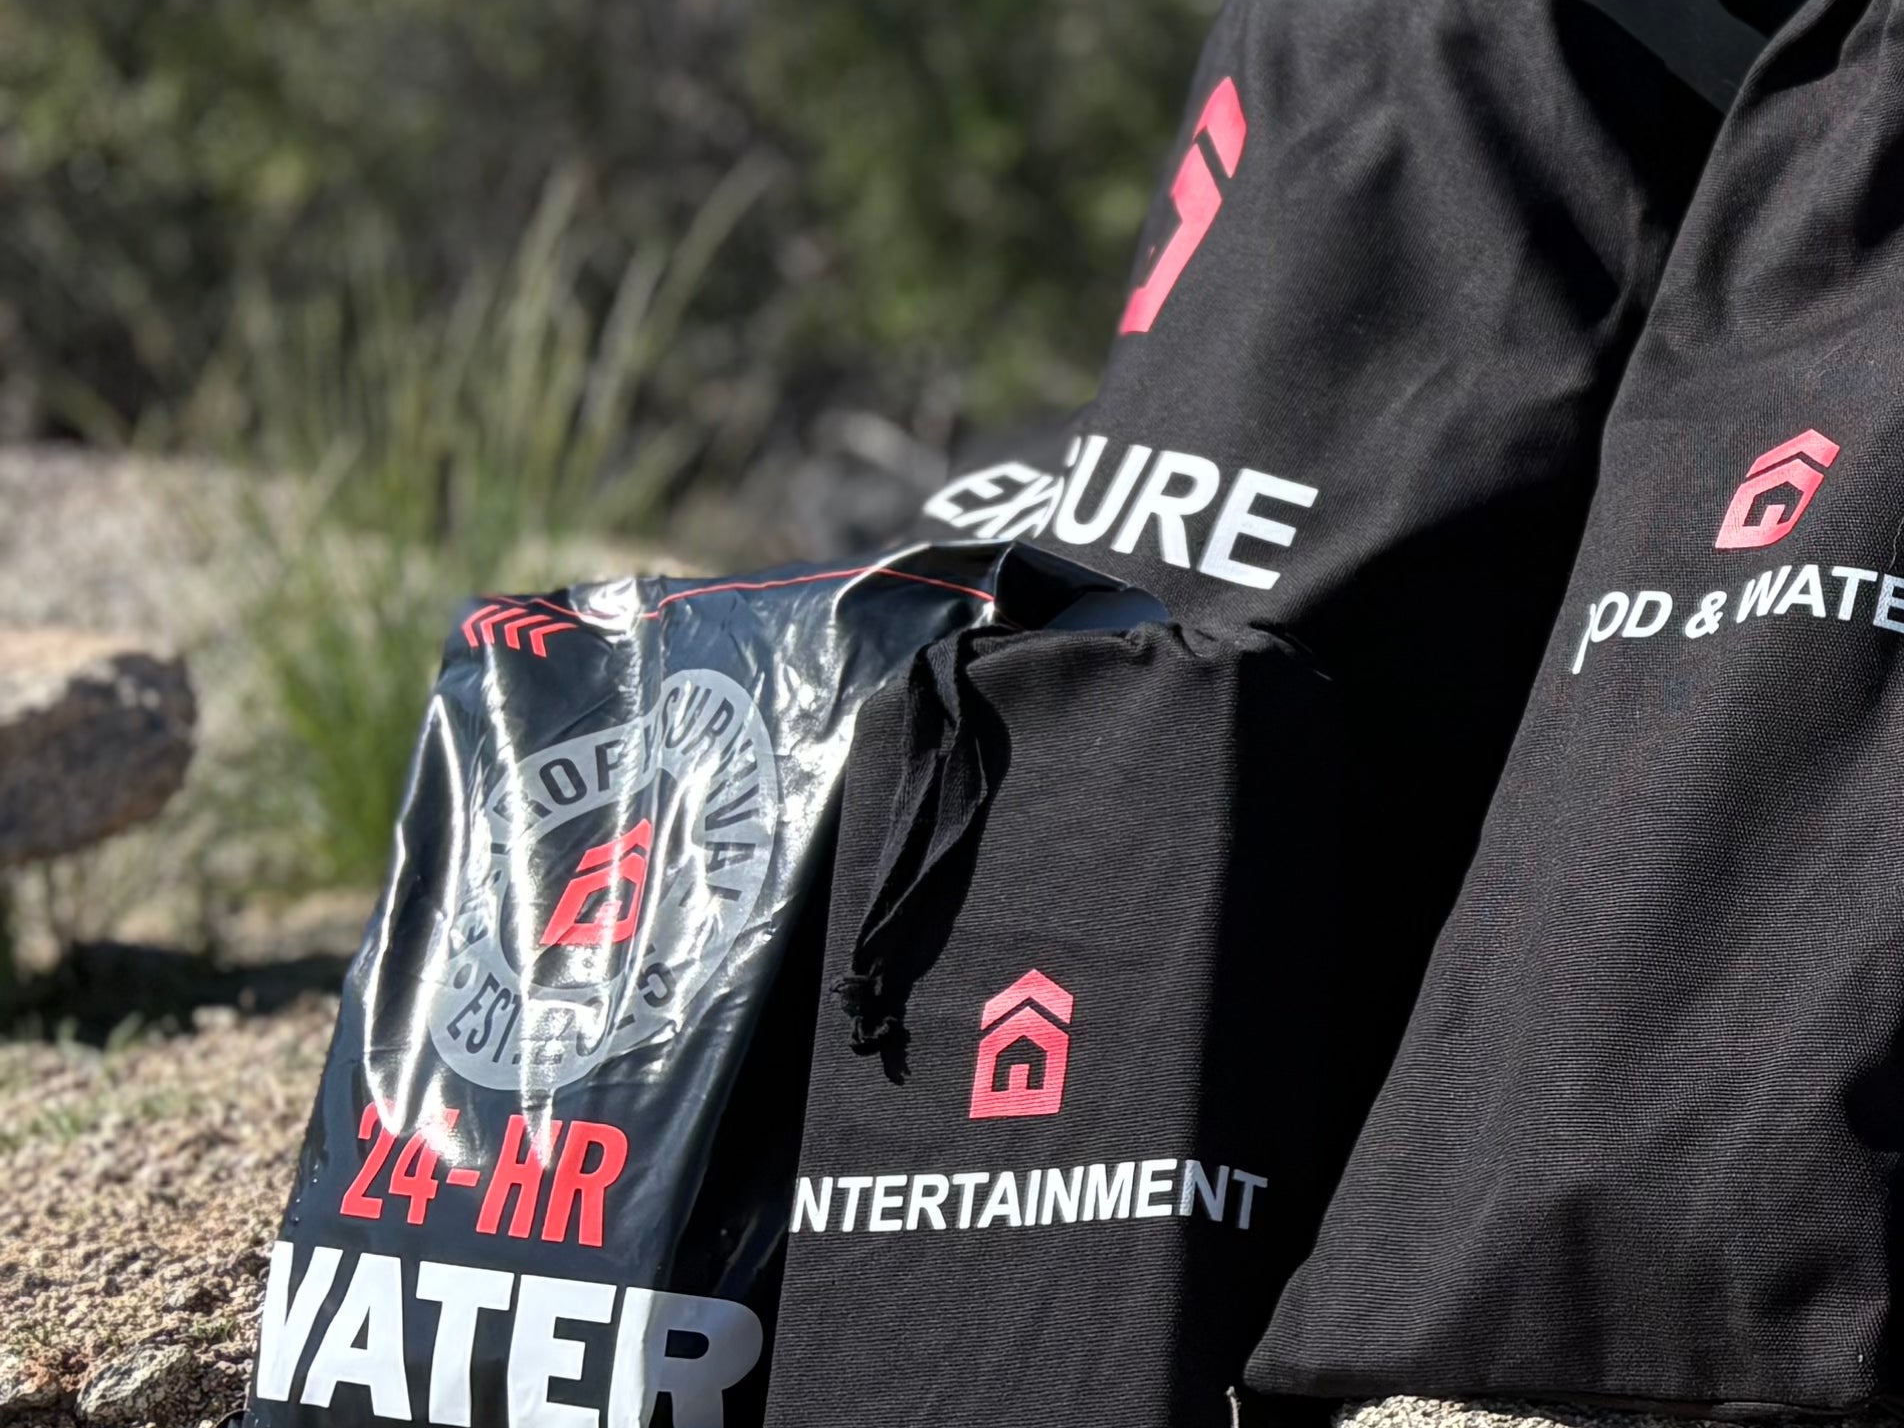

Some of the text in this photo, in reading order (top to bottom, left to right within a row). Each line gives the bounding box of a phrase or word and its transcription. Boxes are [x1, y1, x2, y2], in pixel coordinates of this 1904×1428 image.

[1684, 590, 1728, 639] &
[340, 1098, 630, 1248] 24-HR
[789, 1157, 1268, 1234] NTERTAINMENT
